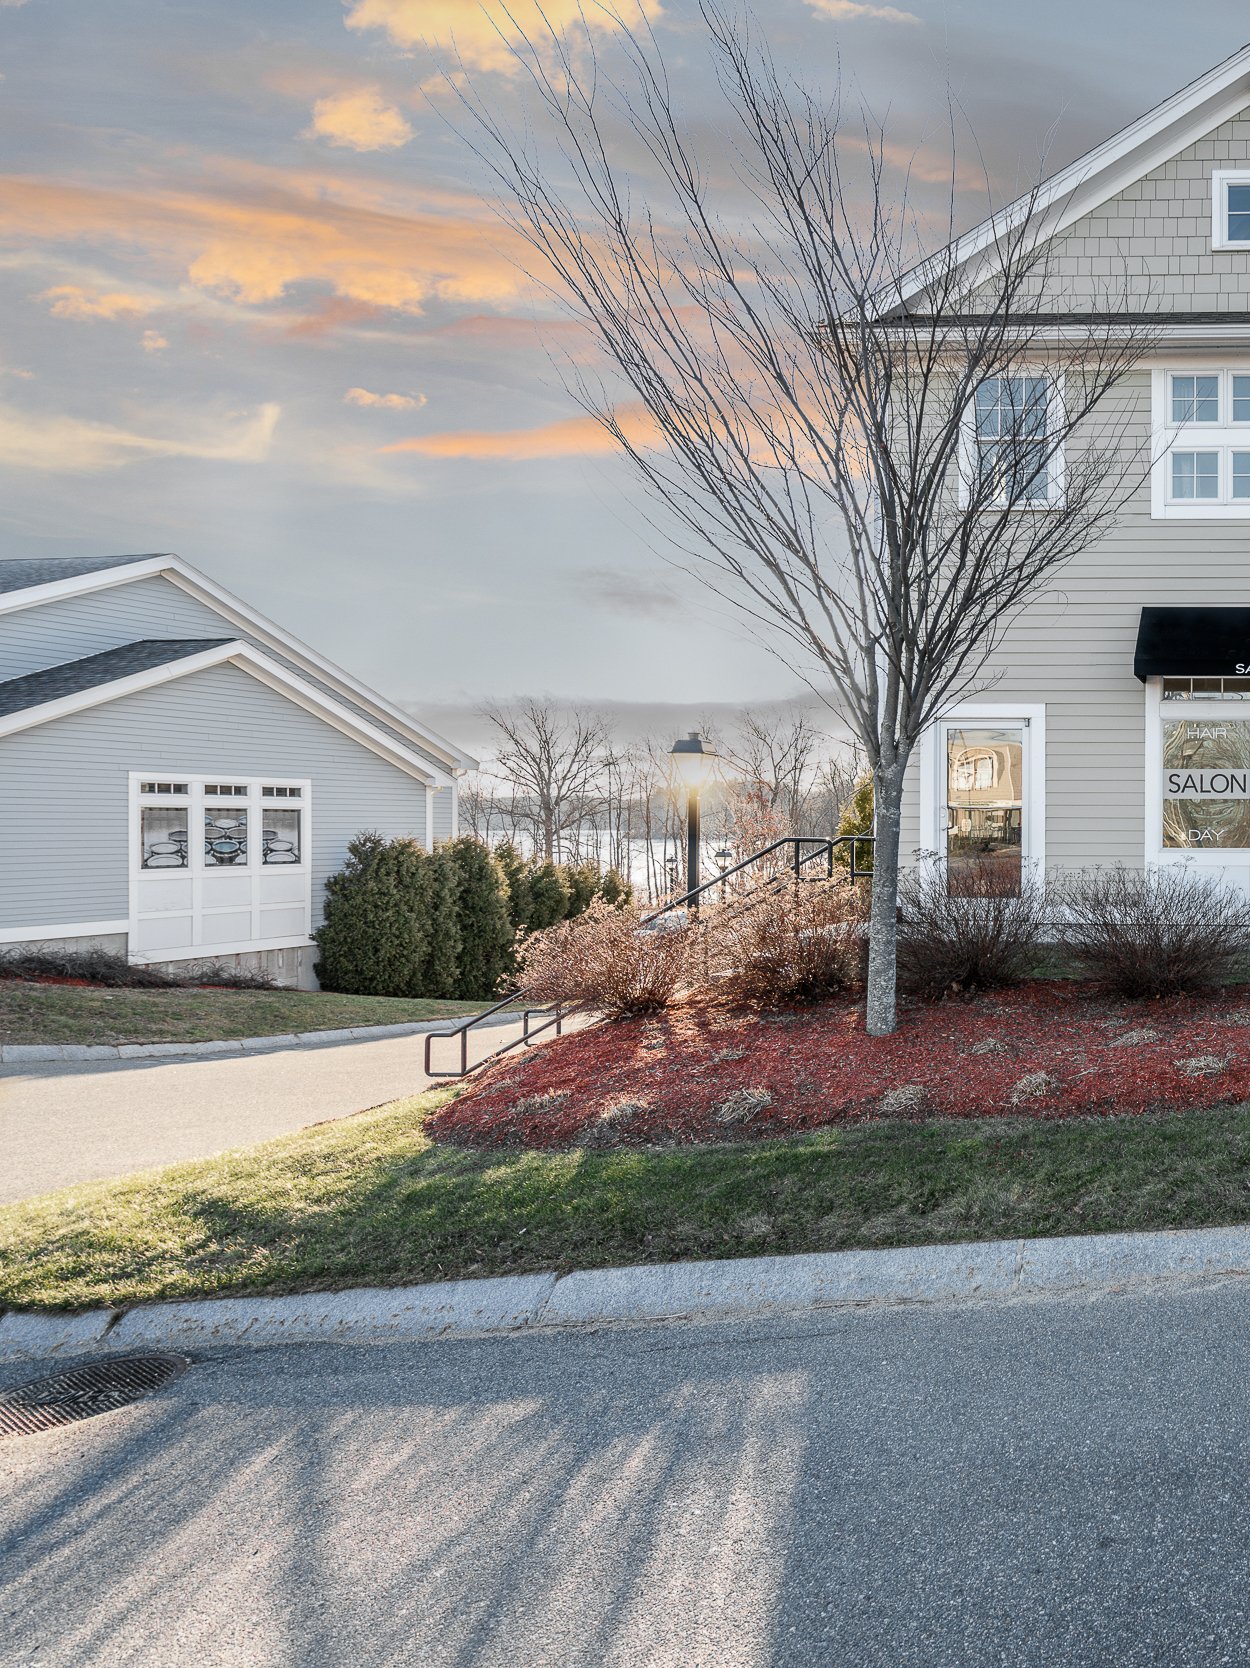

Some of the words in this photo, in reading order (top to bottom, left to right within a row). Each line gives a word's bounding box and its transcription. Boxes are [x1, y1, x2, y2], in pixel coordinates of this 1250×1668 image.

[1187, 727, 1227, 739] HAIR
[1168, 773, 1247, 794] SALON
[1188, 829, 1225, 841] DAY
